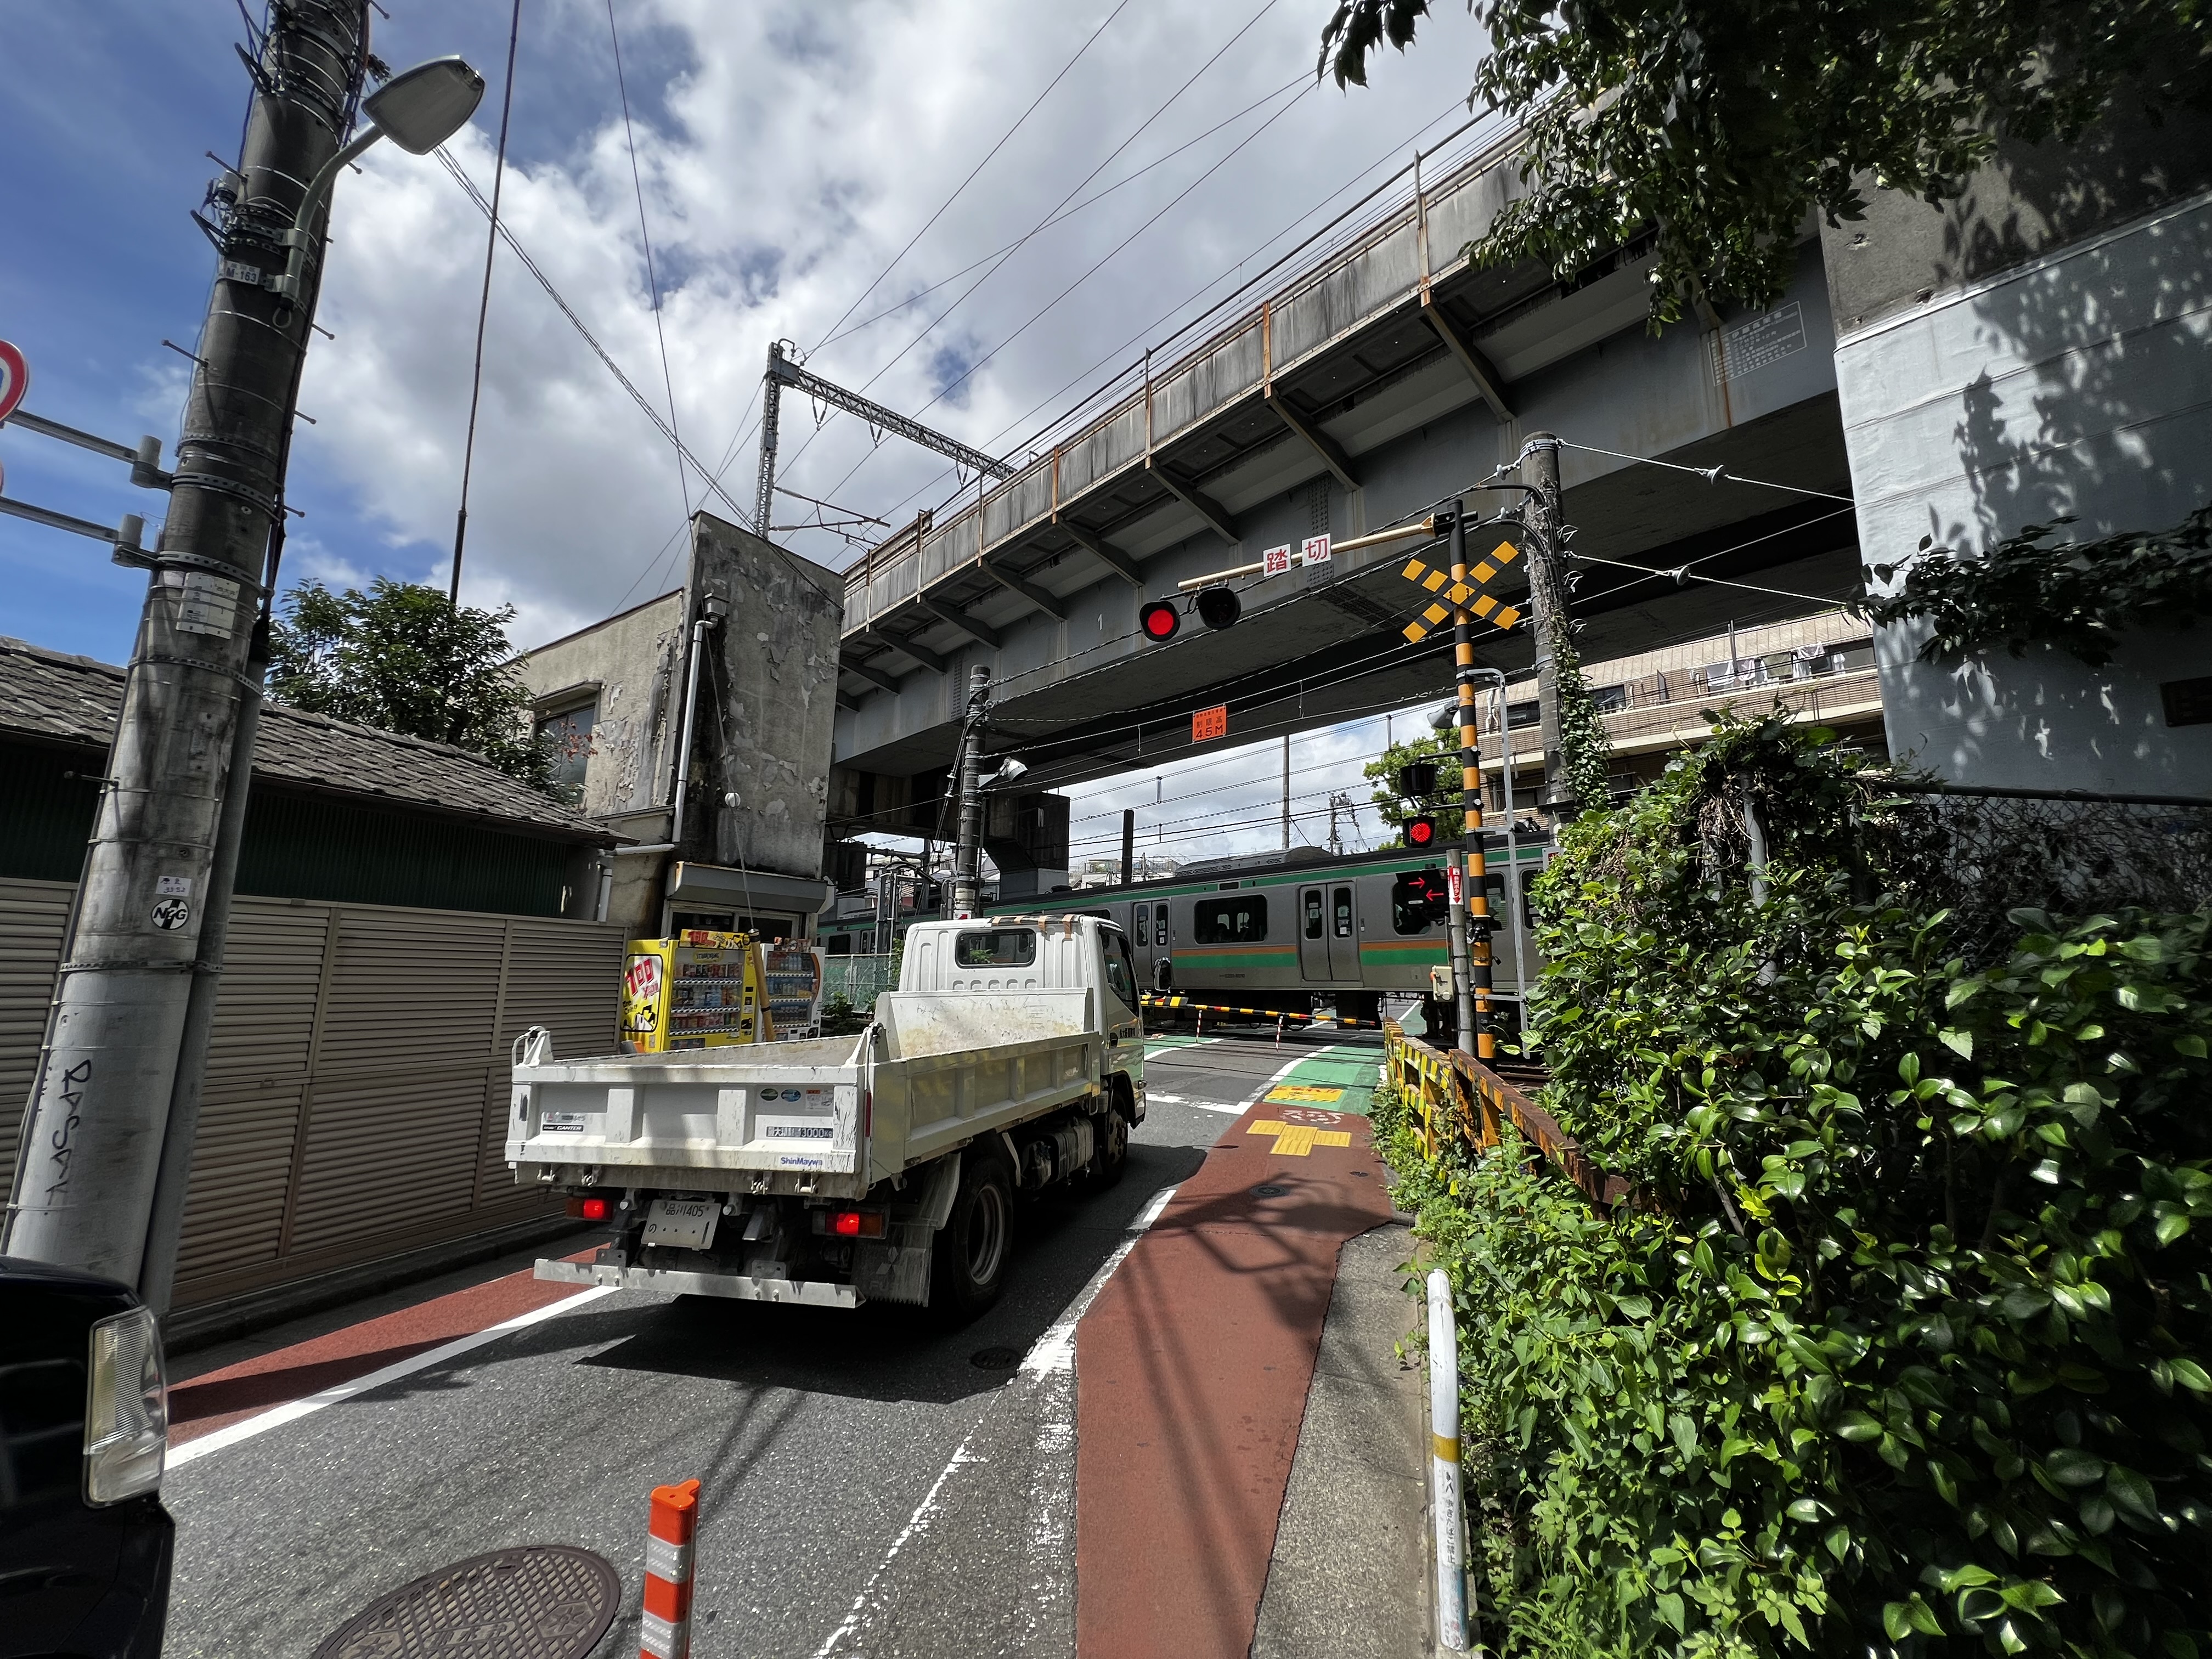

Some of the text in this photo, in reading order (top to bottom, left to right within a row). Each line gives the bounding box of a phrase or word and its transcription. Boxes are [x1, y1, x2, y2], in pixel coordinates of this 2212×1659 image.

[226, 267, 256, 283] M-163
[1267, 538, 1327, 573] 踏切
[1097, 613, 1102, 630] 1
[625, 958, 654, 996] 100
